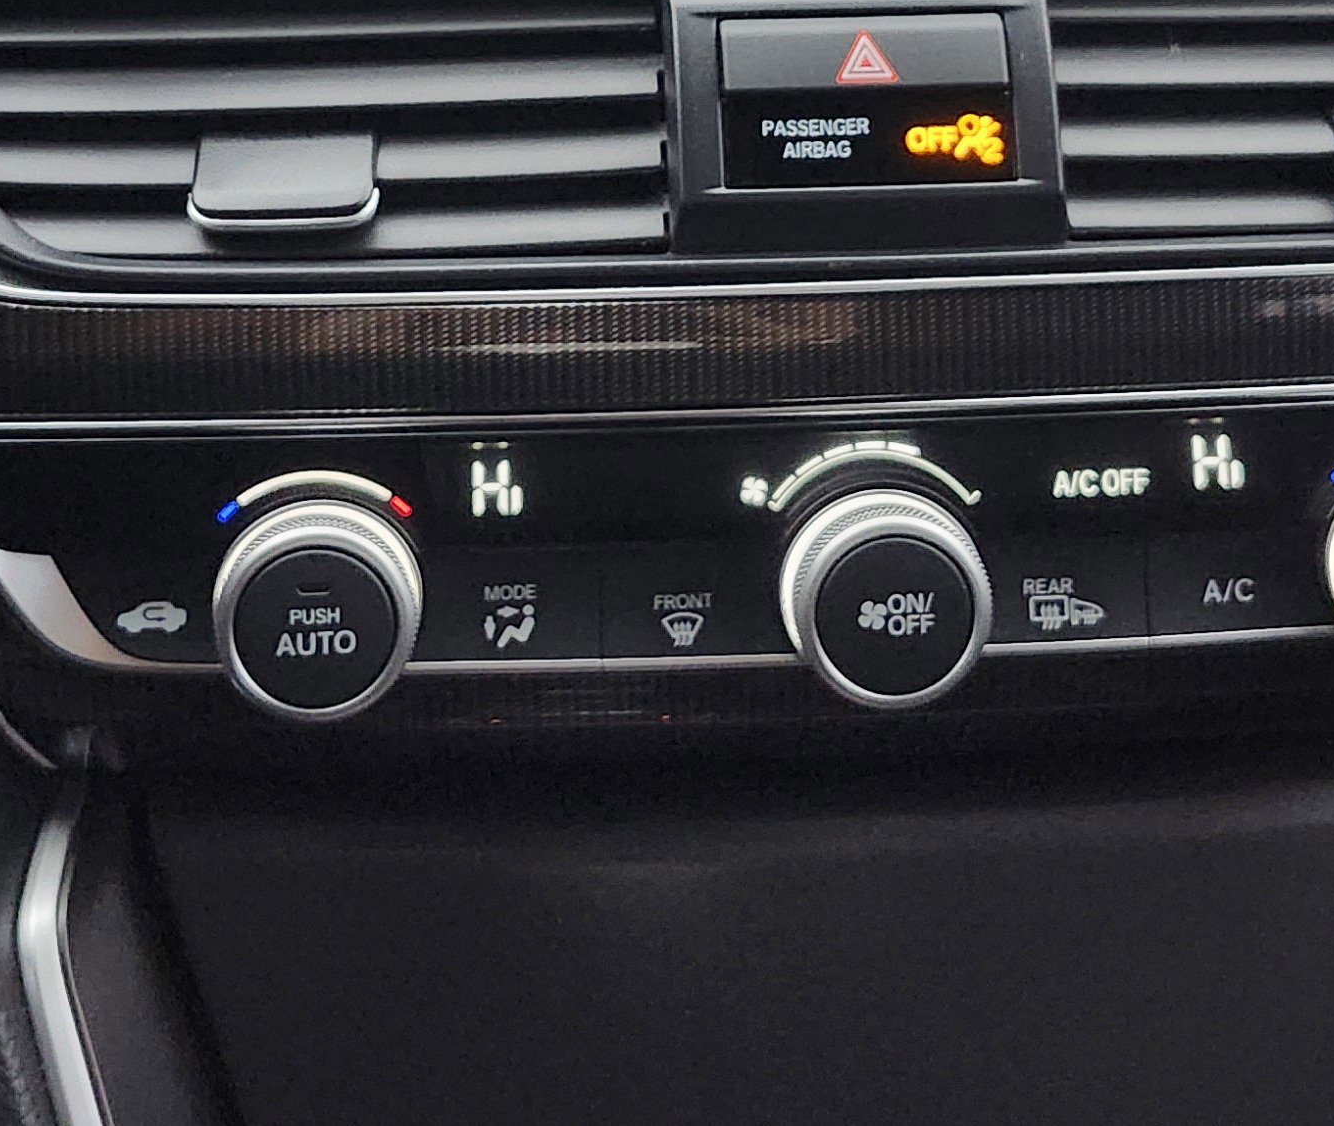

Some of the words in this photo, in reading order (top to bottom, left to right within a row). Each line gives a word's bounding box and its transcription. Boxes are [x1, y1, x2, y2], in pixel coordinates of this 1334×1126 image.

[762, 118, 870, 137] PASSENGER
[783, 140, 851, 158] AIRBAG
[904, 125, 957, 155] OFF
[1053, 469, 1101, 498] A/C
[1101, 468, 1150, 497] OFF
[484, 584, 536, 602] MODE
[1023, 578, 1073, 595] REAR
[1203, 578, 1254, 604] A/C
[653, 593, 712, 611] FRONT
[888, 592, 934, 615] ON/
[289, 607, 340, 625] PUSH
[888, 613, 935, 635] OFF
[276, 630, 356, 656] AUTO
